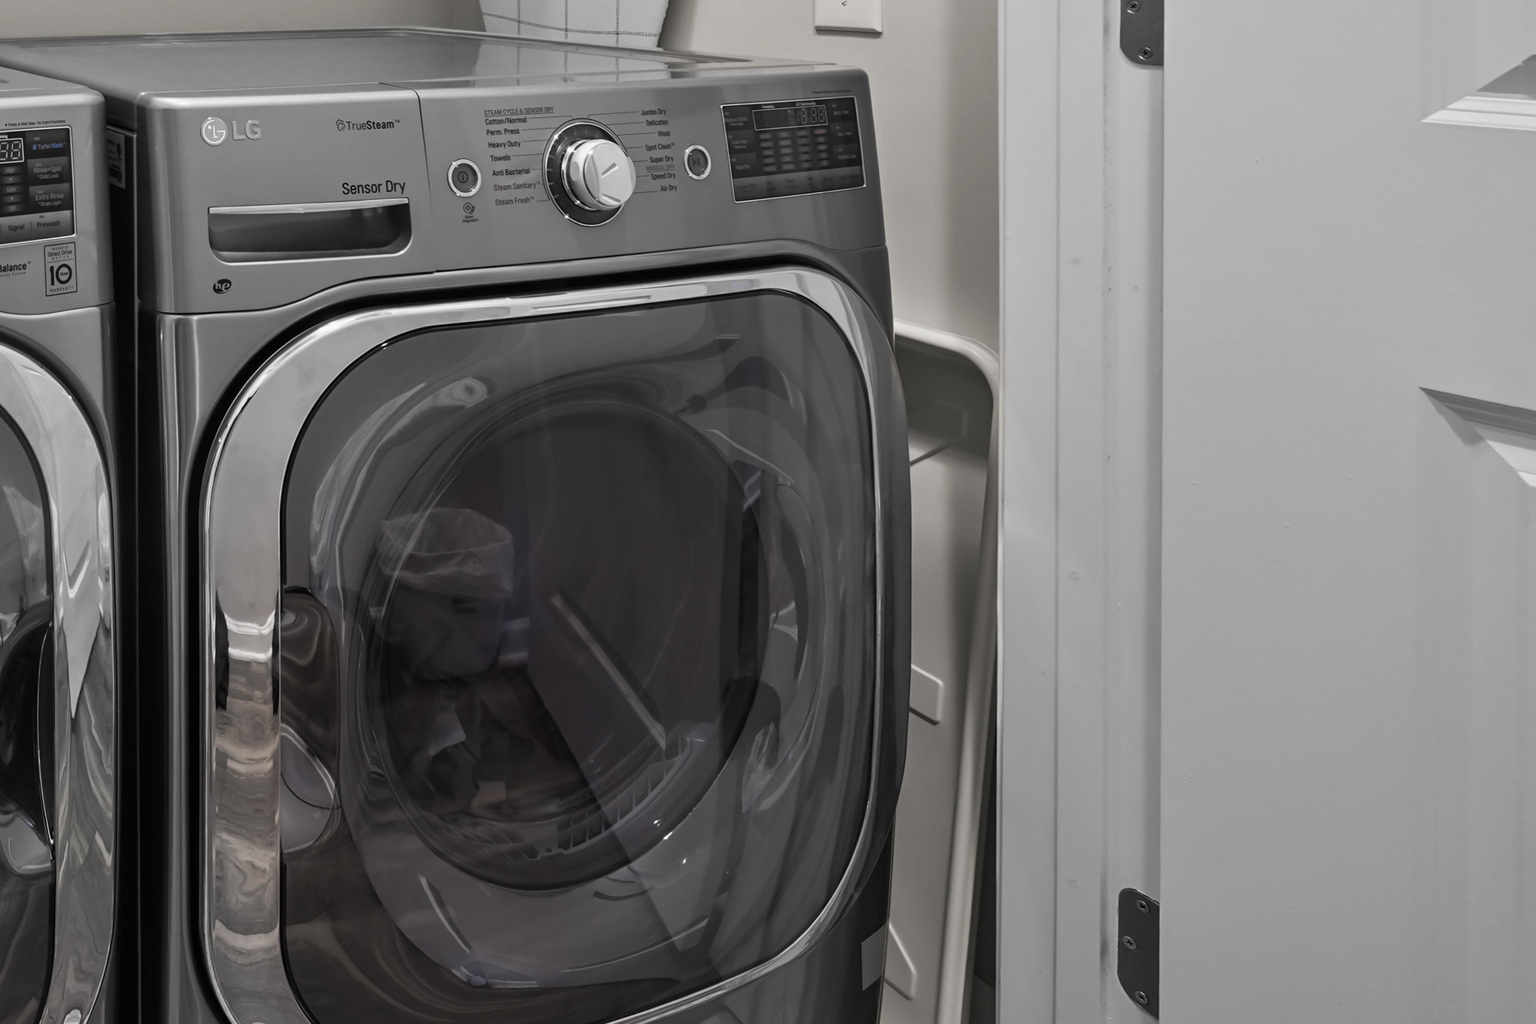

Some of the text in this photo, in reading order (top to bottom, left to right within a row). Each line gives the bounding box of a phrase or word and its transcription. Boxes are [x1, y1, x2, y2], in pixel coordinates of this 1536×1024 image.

[231, 120, 261, 140] LG
[485, 117, 527, 126] Cotton/Normal
[342, 180, 406, 195] Sensor Dry
[50, 264, 72, 286] 10
